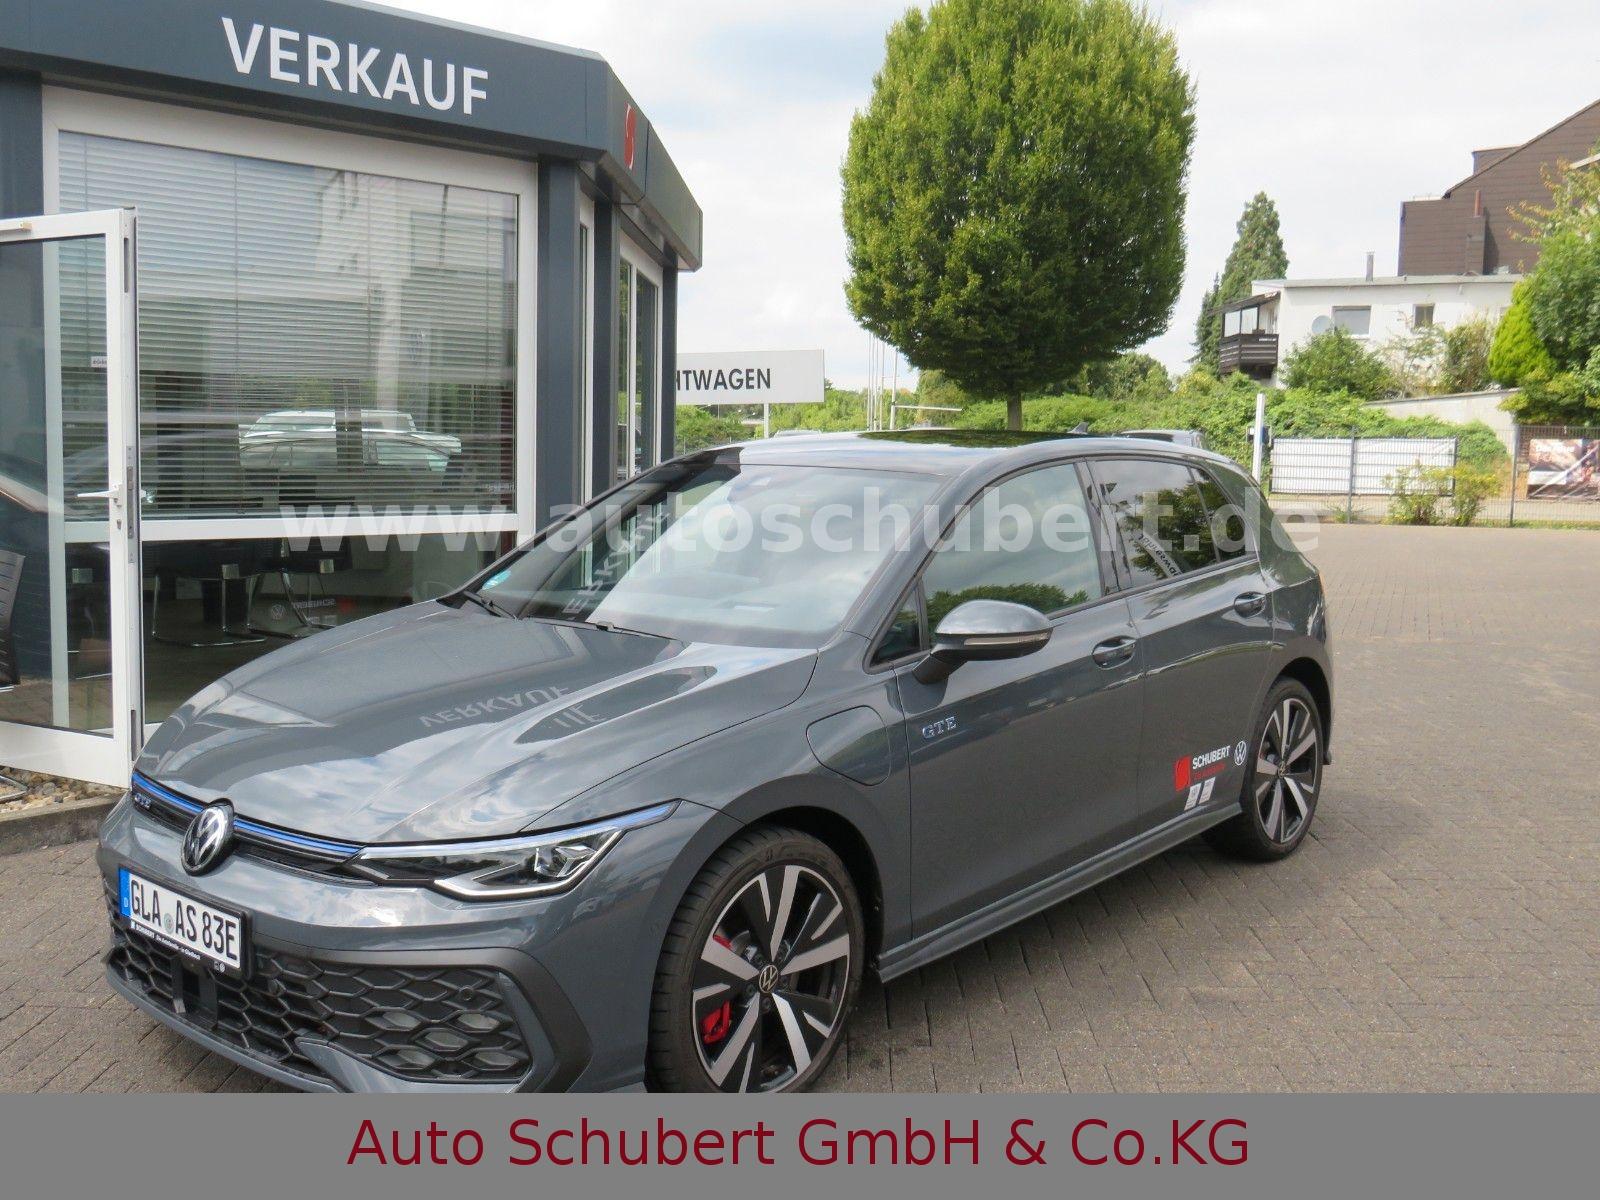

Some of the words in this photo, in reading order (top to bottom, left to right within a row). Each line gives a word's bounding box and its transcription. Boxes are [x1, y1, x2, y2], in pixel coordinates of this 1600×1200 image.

[221, 16, 489, 116] VERKAUF
[922, 716, 957, 738] GTE
[1192, 745, 1231, 770] SCHUBERT
[131, 879, 162, 928] GLA
[175, 899, 198, 942] AS
[202, 911, 238, 961] 83E
